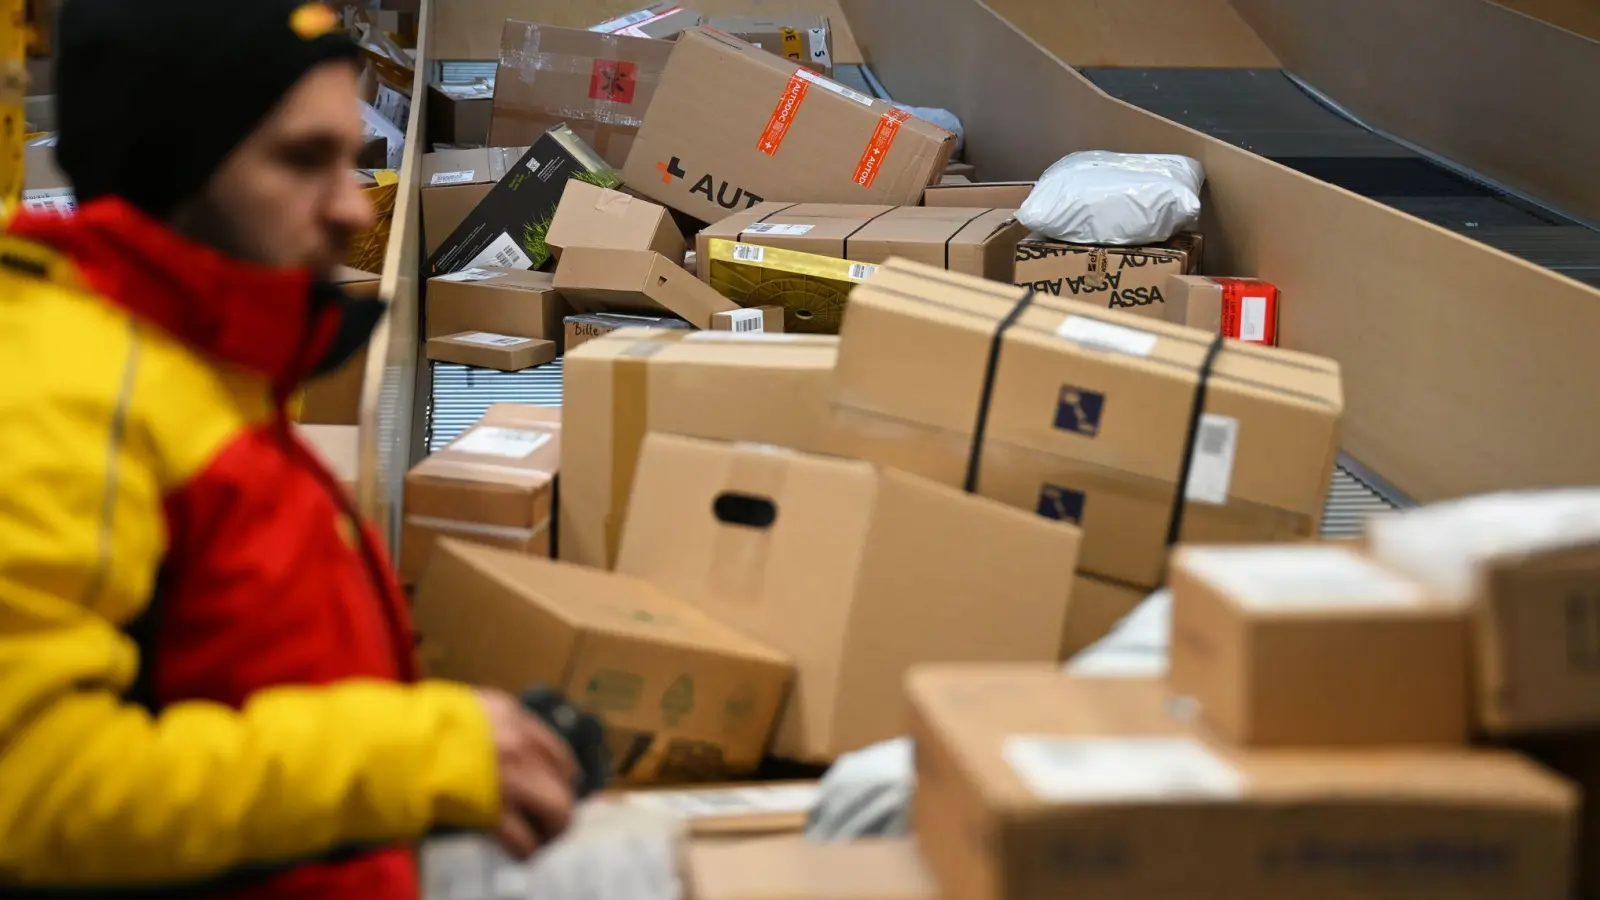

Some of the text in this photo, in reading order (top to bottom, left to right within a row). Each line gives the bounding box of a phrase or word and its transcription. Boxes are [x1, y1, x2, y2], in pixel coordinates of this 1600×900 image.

[779, 83, 801, 122] AUTODOC
[858, 155, 876, 185] AUTOD
[1108, 285, 1165, 309] ASSA
